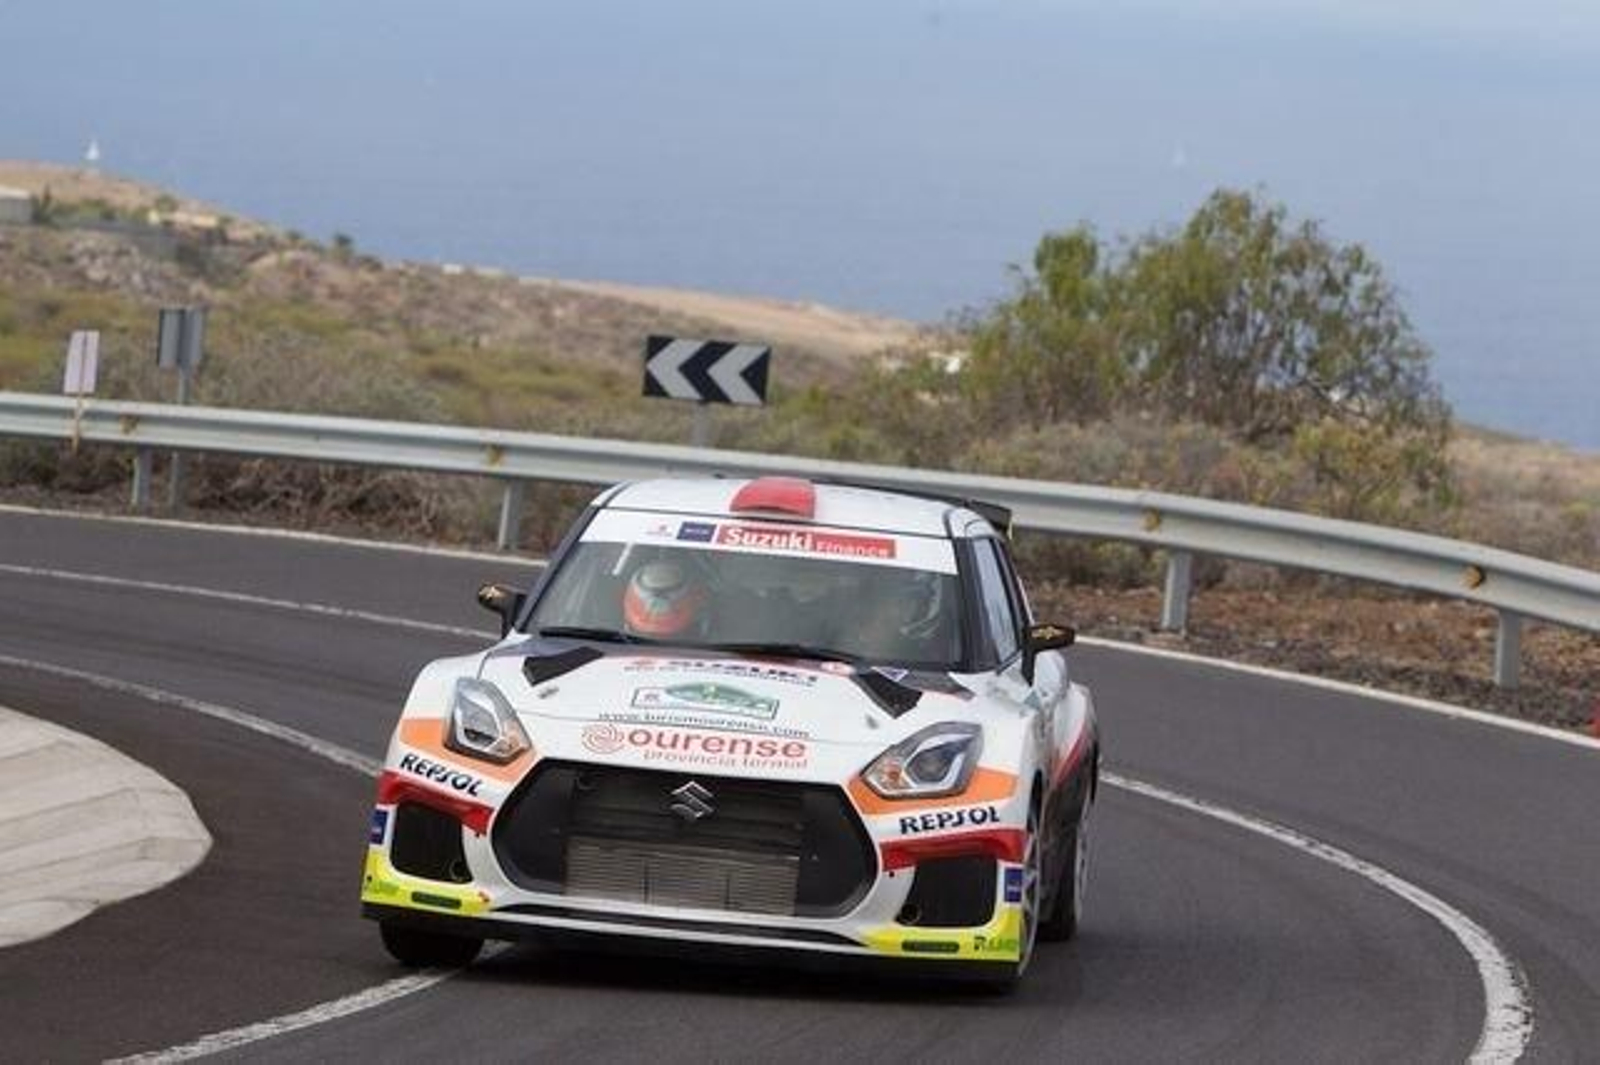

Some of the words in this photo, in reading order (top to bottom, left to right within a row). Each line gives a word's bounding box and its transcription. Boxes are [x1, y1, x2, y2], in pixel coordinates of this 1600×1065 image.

[726, 526, 812, 552] Suzuki
[628, 728, 807, 758] ourense
[643, 749, 737, 768] provincia
[400, 754, 482, 796] REPSOL
[899, 806, 1000, 834] REPSOL
